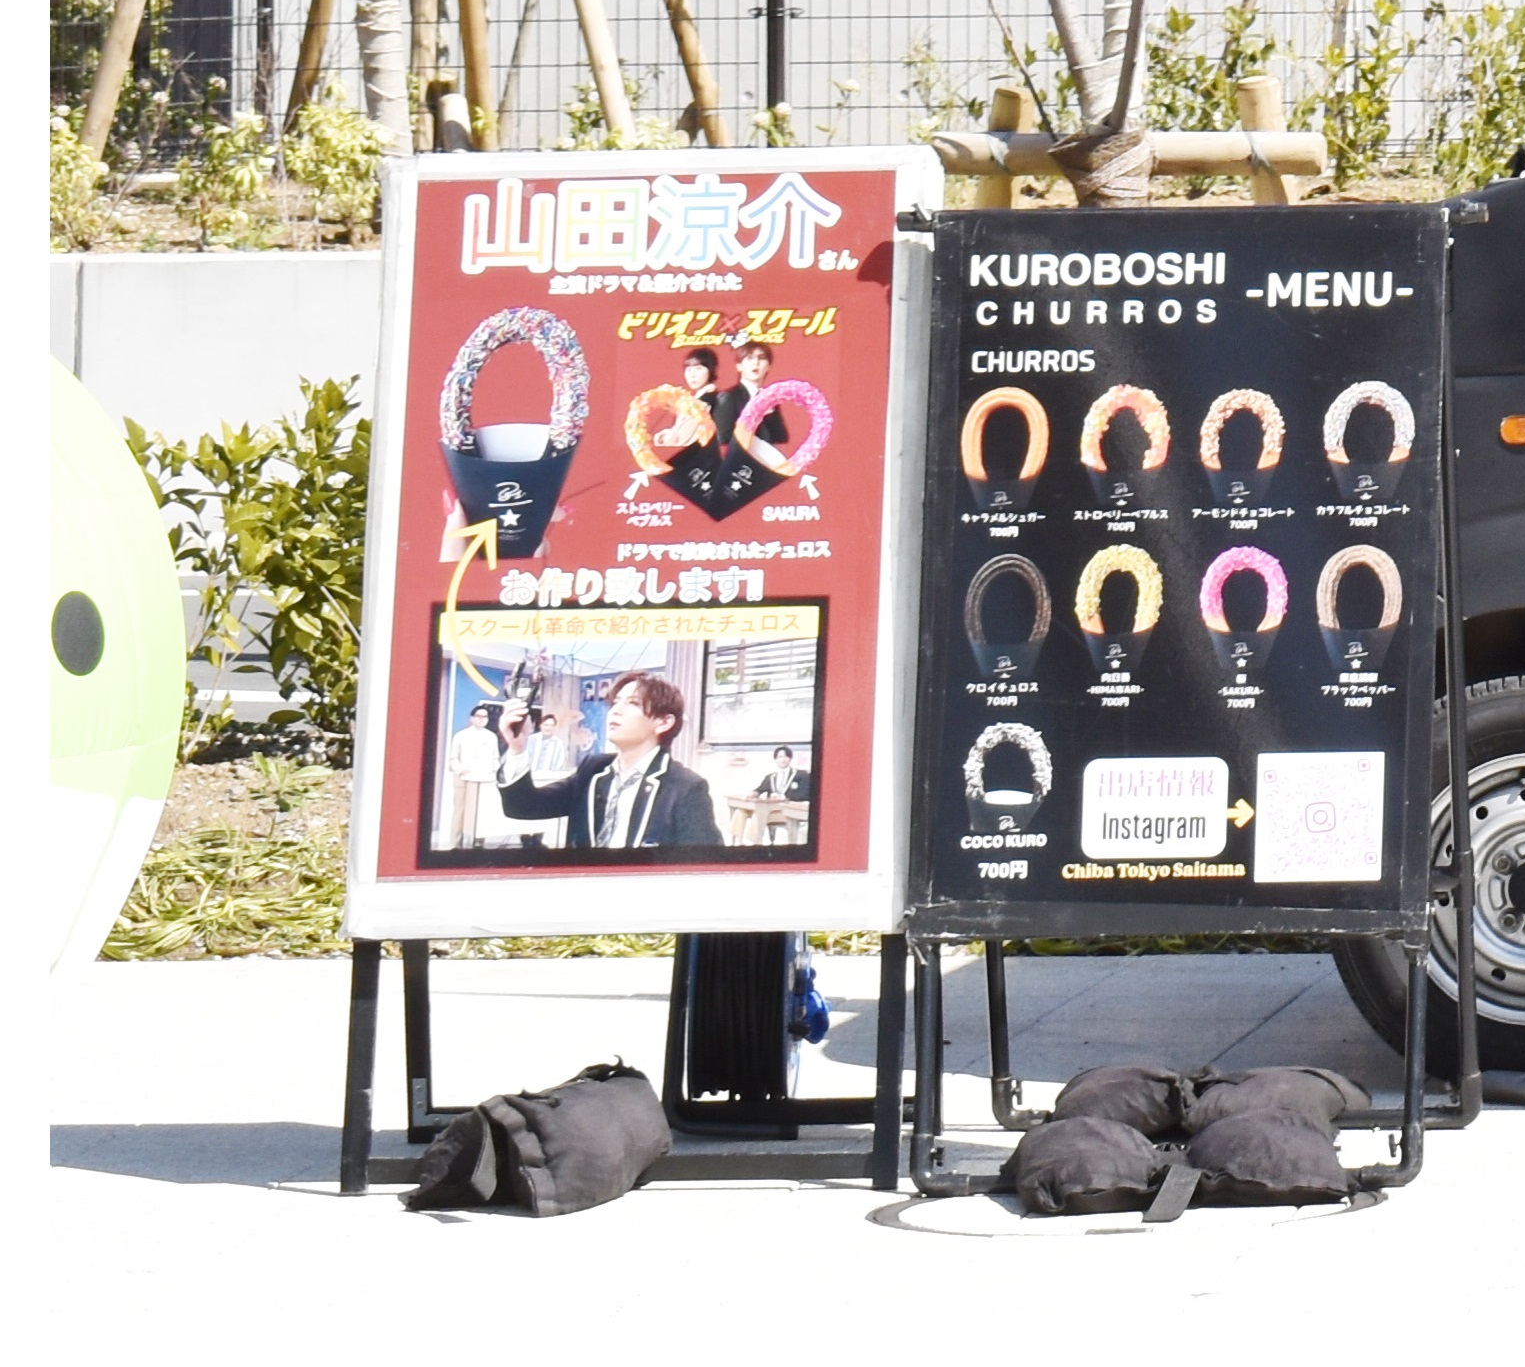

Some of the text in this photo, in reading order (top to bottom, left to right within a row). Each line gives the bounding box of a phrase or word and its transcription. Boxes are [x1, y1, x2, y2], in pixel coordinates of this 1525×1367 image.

[461, 173, 842, 275] 山田涼介
[970, 252, 1226, 287] KUROBOSHI
[1245, 271, 1414, 307] -MENU-
[976, 298, 1217, 325] CHURROS
[971, 350, 1095, 373] CHURROS
[762, 506, 820, 521] SAKURA
[457, 613, 800, 638] スクール革命で紹介されたチュロス
[1102, 811, 1207, 844] Instagram
[961, 833, 1047, 850] COCO KURO
[978, 860, 1028, 879] 700円
[1062, 861, 1246, 880] Chiba Tokyo Saitama
